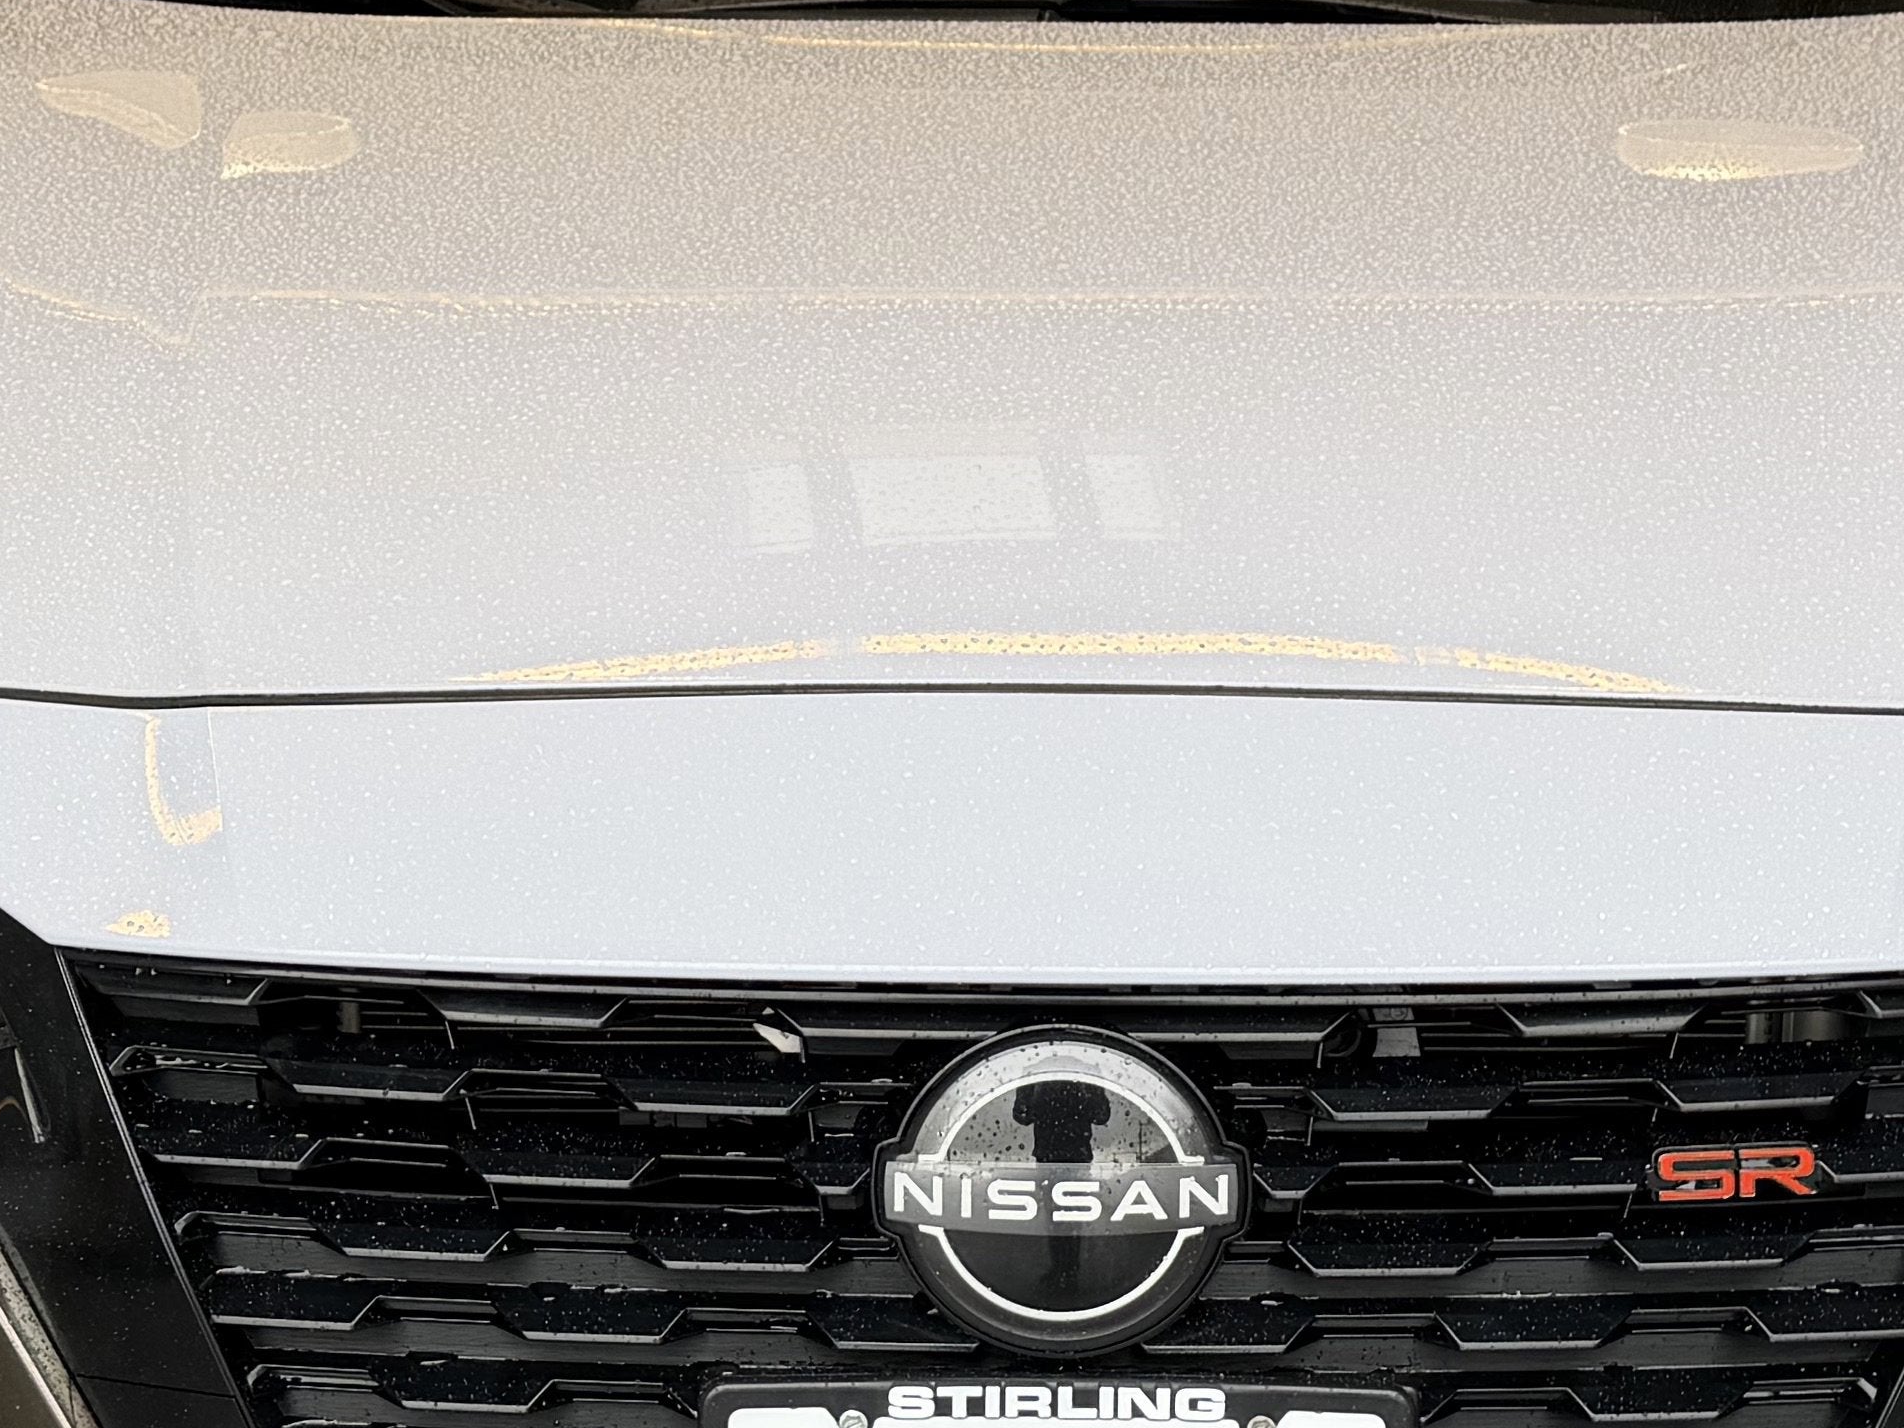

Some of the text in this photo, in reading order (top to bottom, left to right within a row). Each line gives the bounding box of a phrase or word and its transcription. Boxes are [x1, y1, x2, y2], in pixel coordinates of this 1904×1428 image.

[894, 1172, 1229, 1222] NISSAN
[1658, 1146, 1816, 1201] SR
[887, 1385, 1227, 1422] STIRLING
